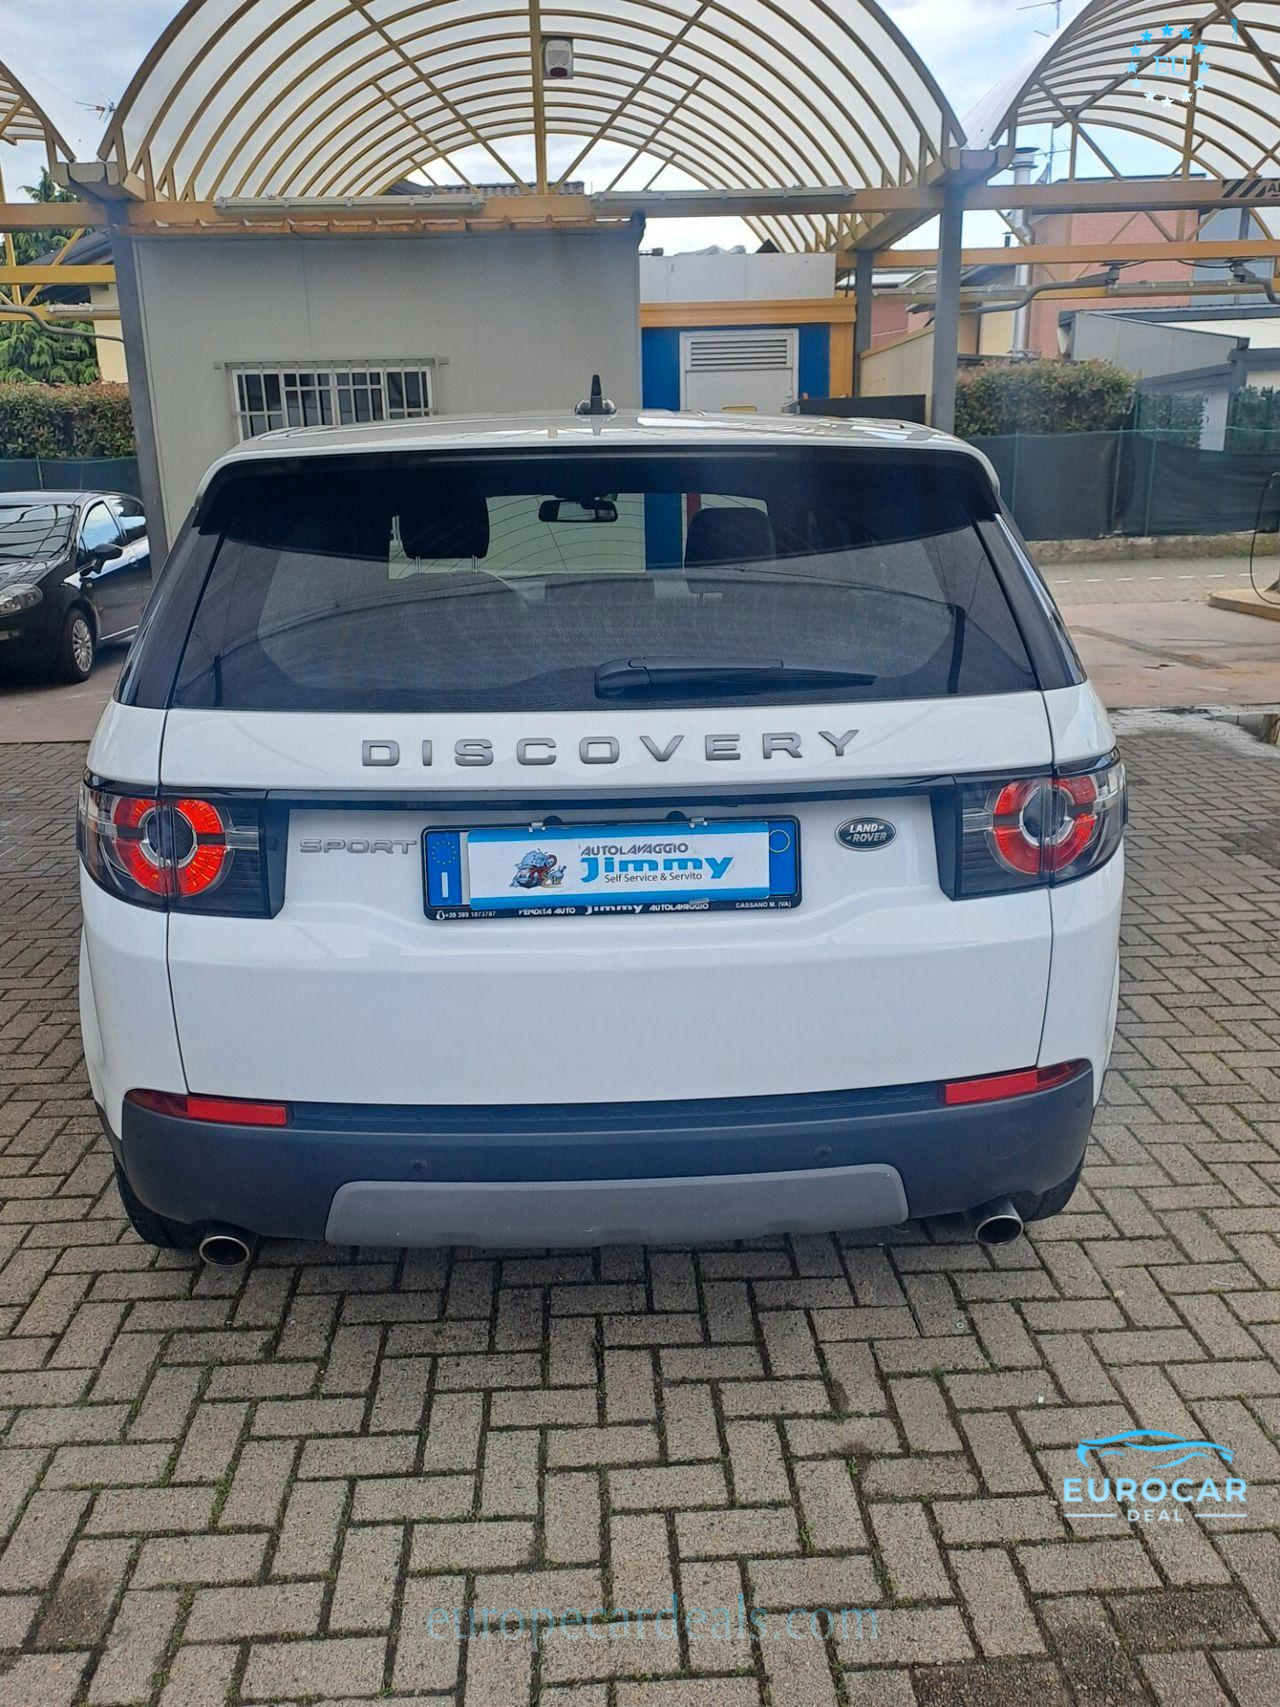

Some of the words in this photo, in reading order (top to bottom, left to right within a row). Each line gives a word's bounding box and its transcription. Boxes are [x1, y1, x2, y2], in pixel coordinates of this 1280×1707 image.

[362, 729, 860, 767] DISCOVERY
[849, 823, 878, 833] LAND
[852, 832, 888, 842] ROVER
[300, 838, 417, 855] SPORT
[580, 843, 689, 857] AUTOLAVAGGIO
[604, 874, 622, 883] Self
[624, 872, 658, 883] Service
[660, 873, 667, 881] &
[669, 871, 702, 881] Servito
[518, 908, 552, 916] VENDITA
[554, 907, 576, 915] AUTO
[649, 903, 709, 911] AUTOLAVAGGIO
